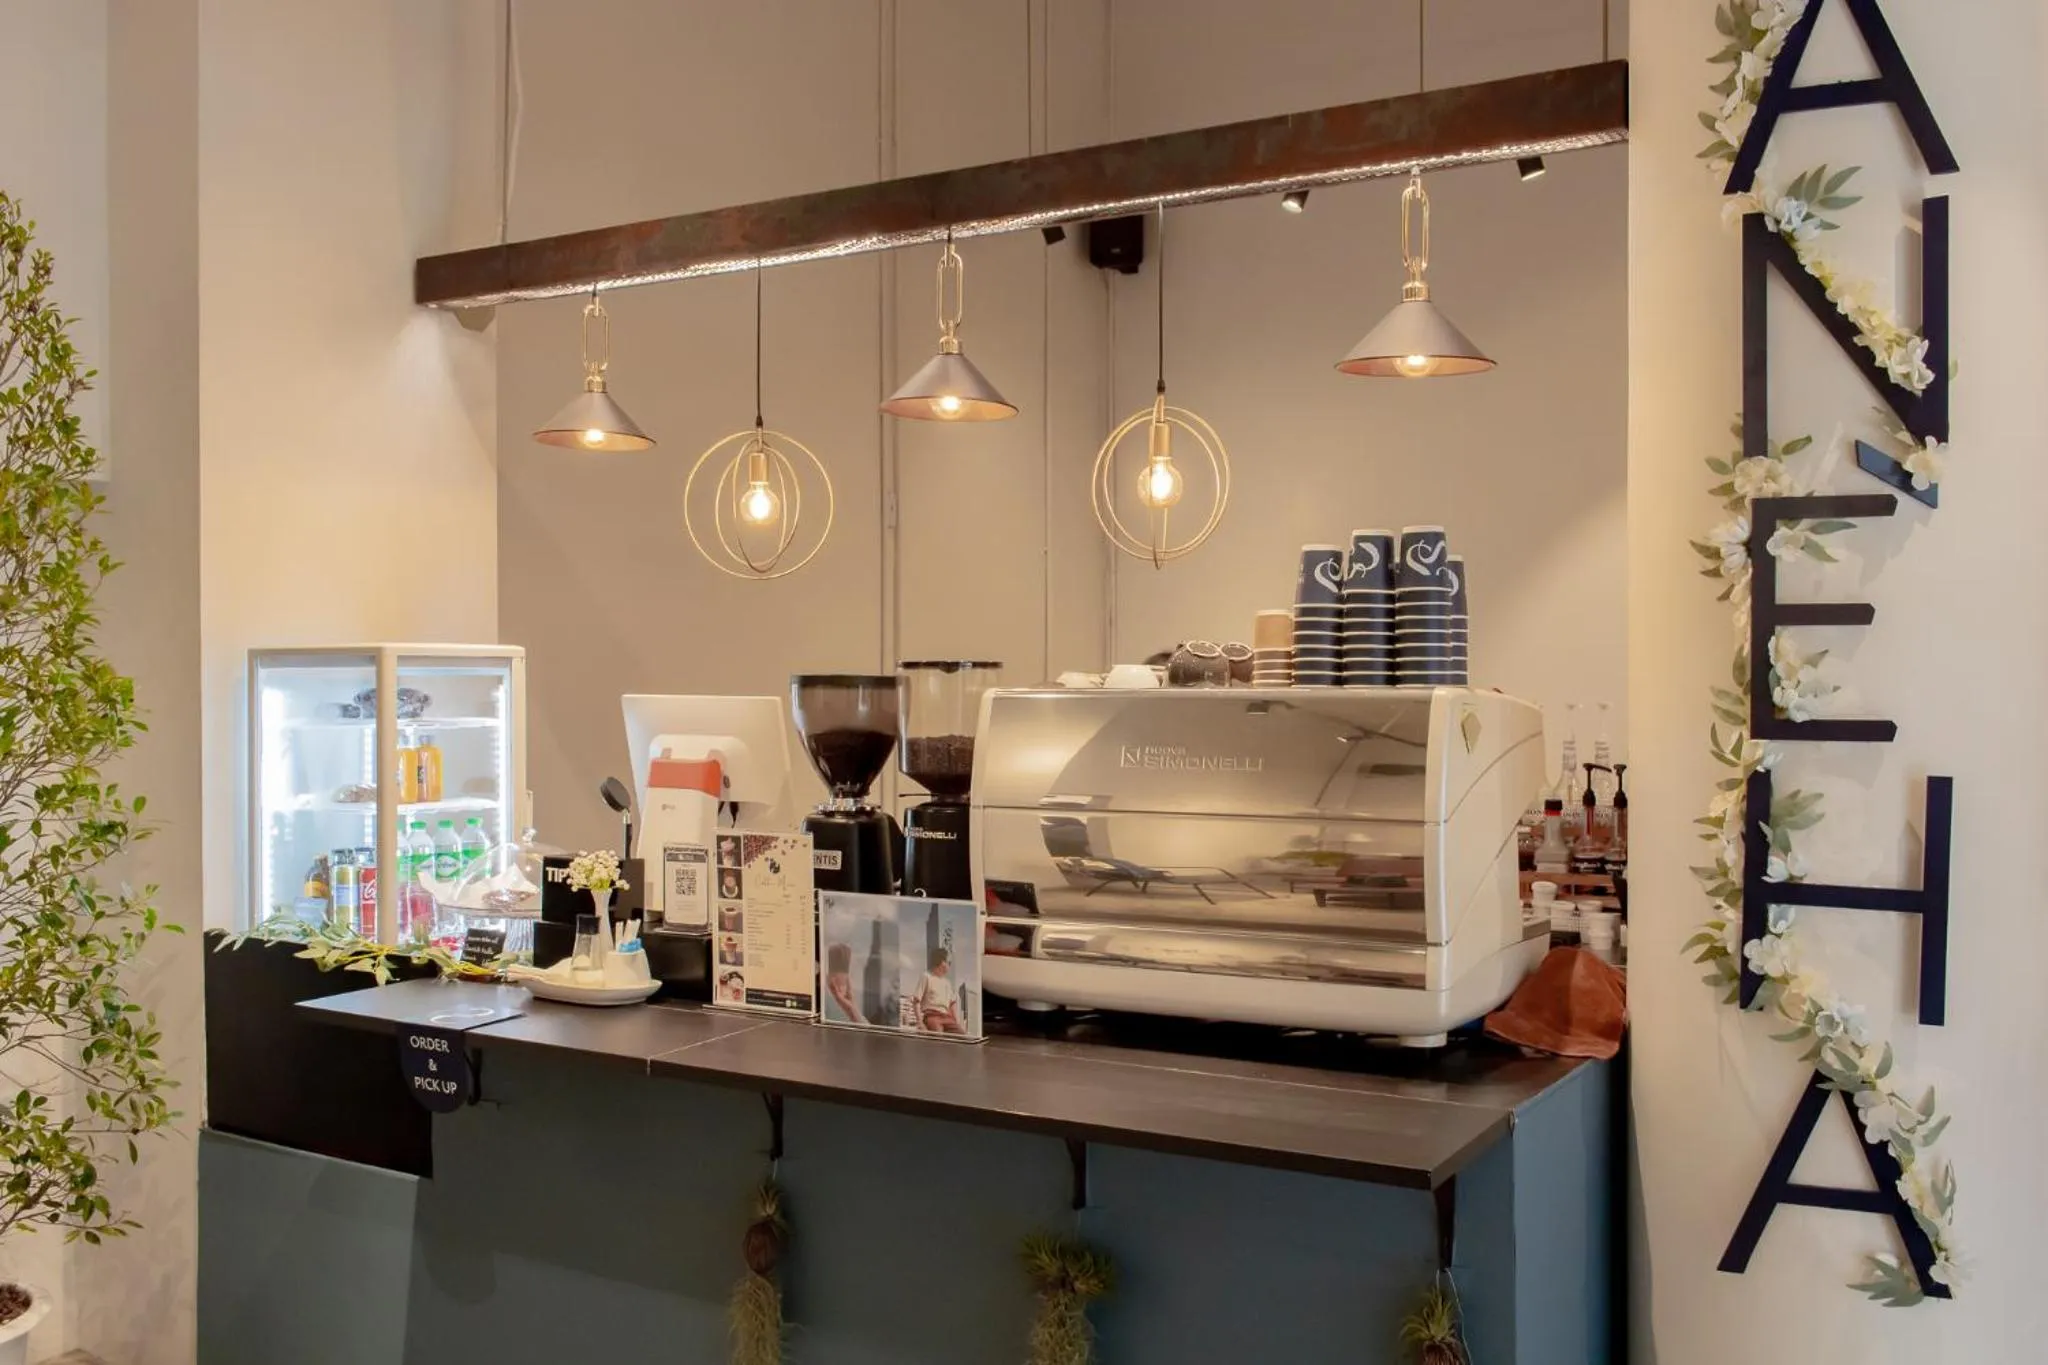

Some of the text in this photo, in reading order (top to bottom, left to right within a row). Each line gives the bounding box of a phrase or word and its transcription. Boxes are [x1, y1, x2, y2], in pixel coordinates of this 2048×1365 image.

[409, 1035, 450, 1053] ORDER
[428, 1058, 438, 1072] &
[413, 1076, 458, 1095] PICK UP
